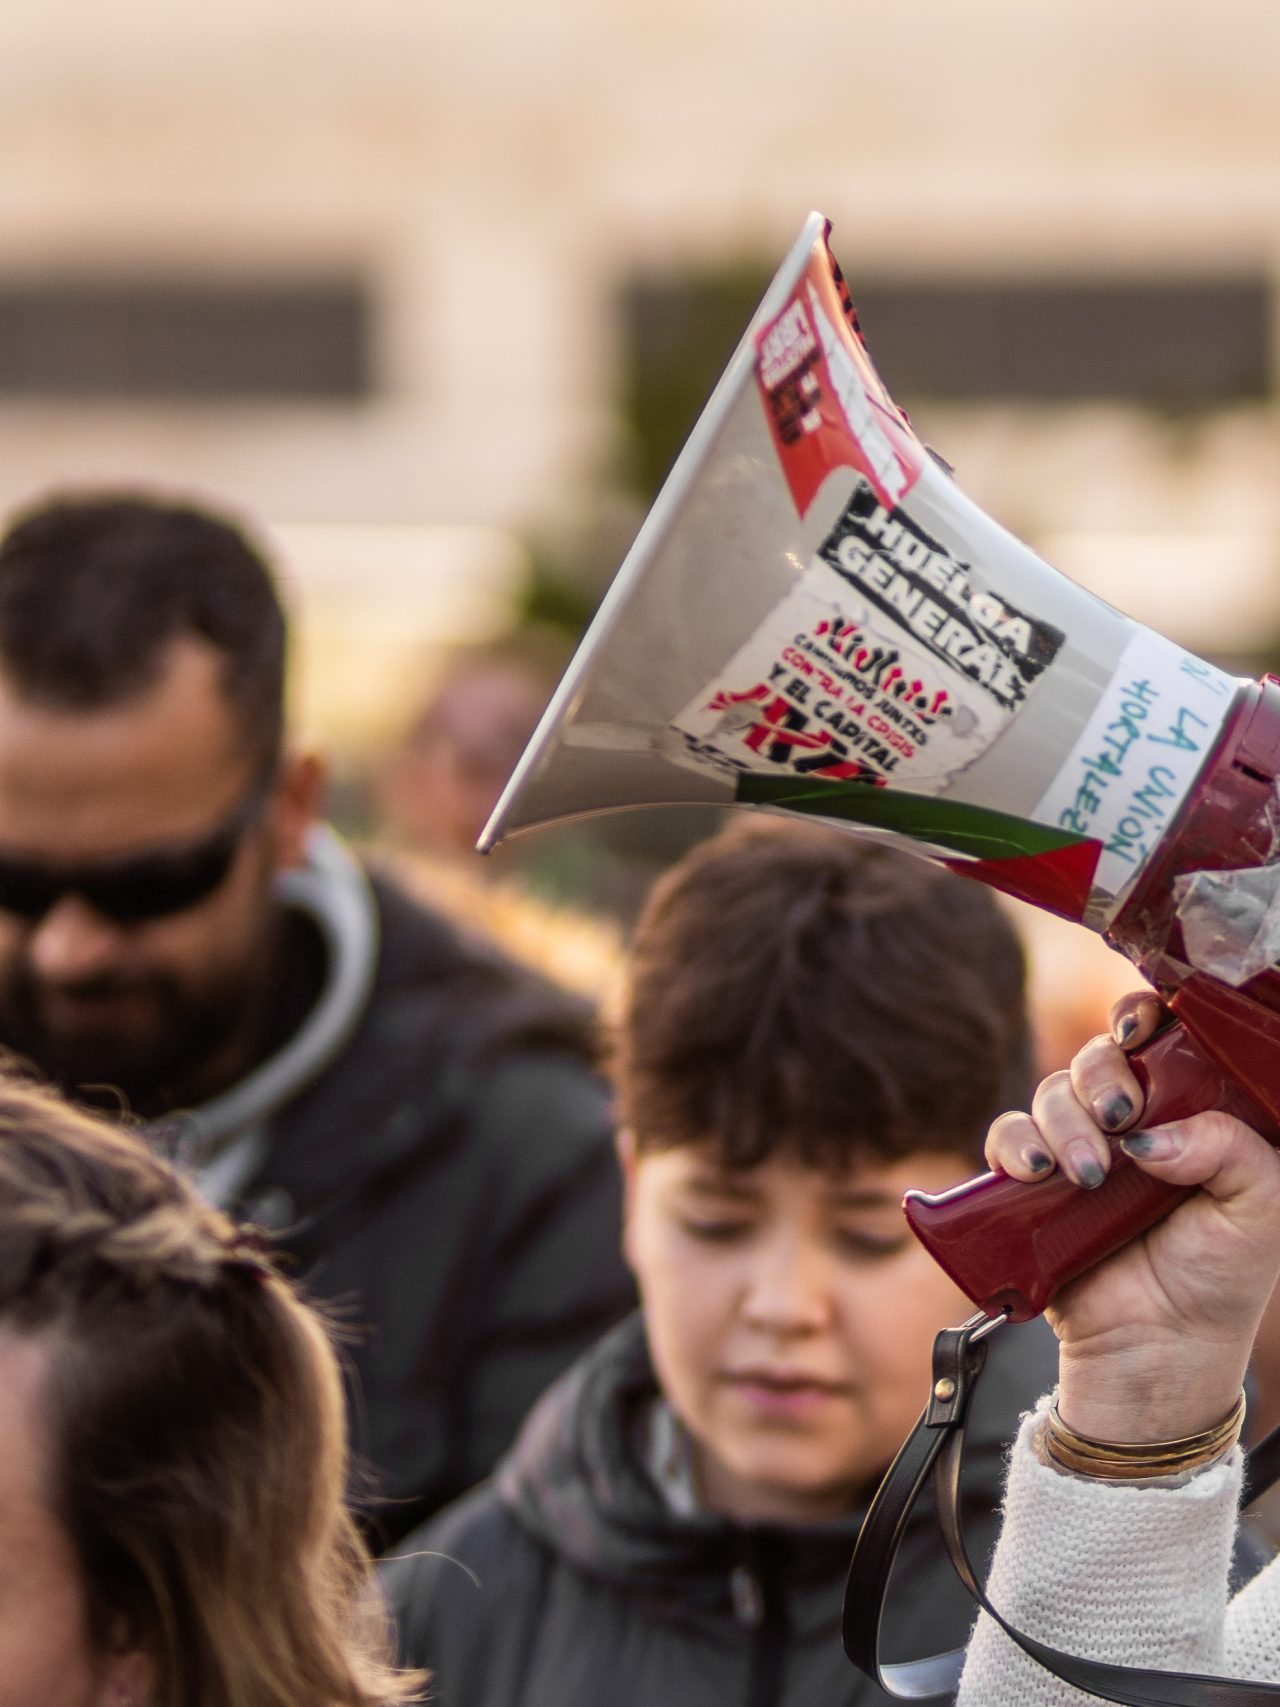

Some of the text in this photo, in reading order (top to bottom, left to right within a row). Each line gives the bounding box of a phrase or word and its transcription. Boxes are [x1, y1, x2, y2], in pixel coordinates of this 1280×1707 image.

[835, 534, 1026, 699] GENERAL
[862, 506, 1032, 656] HUELGA
[767, 662, 900, 773] Y EL CAPITAL
[874, 697, 928, 746] JUNTXS
[1146, 706, 1209, 752] LA
